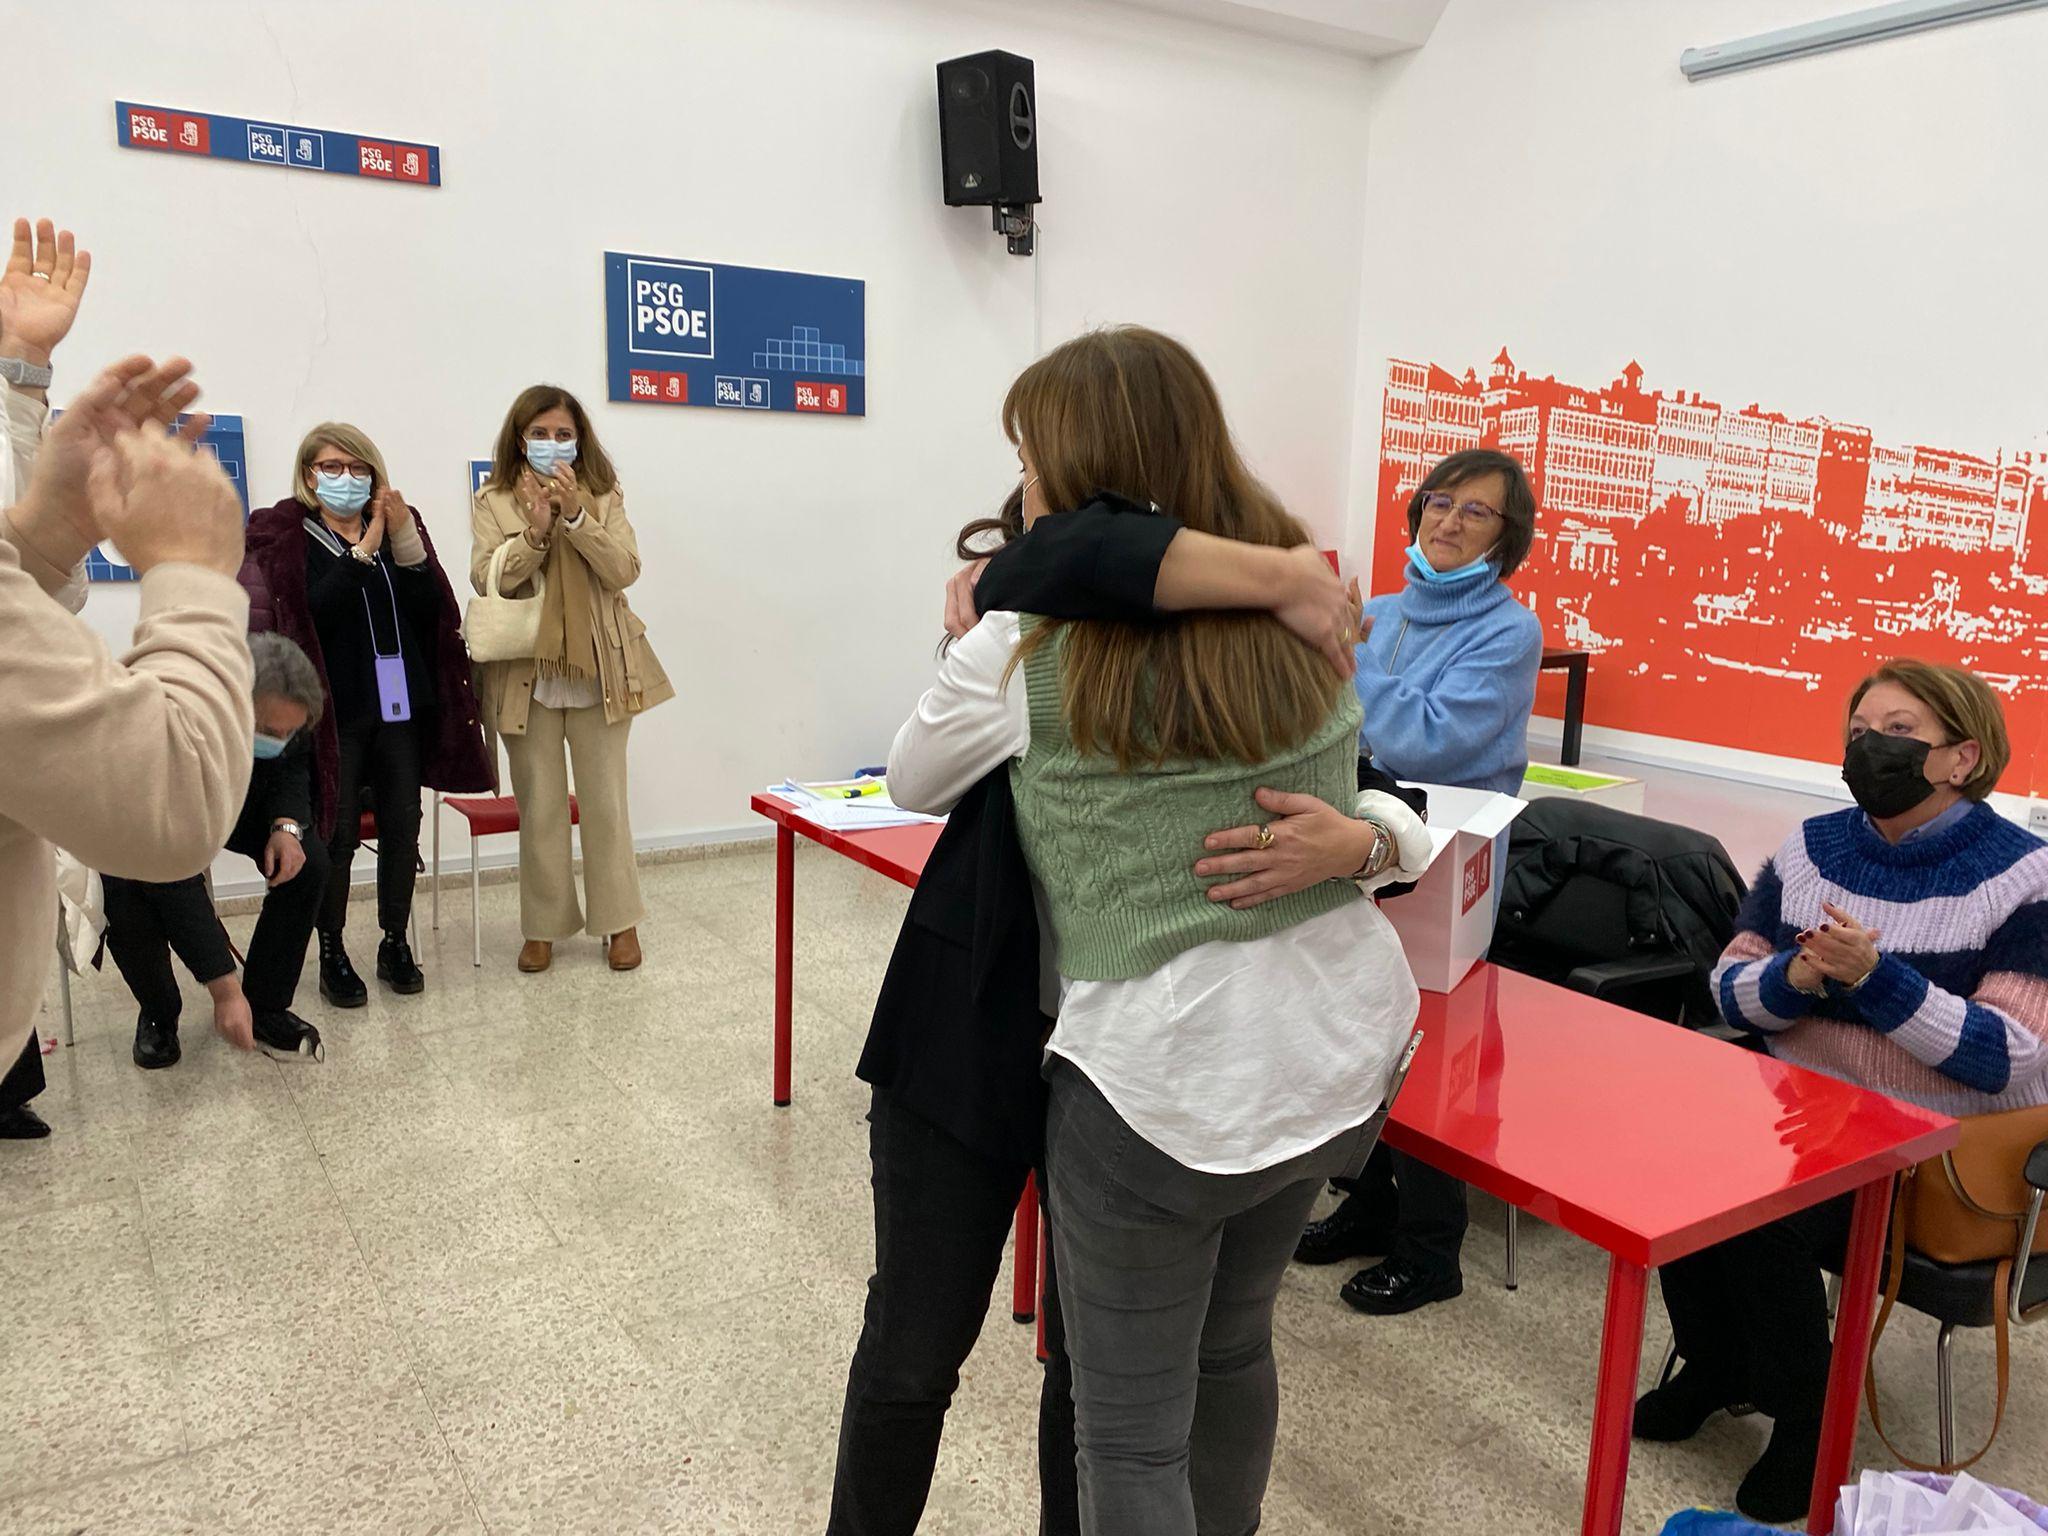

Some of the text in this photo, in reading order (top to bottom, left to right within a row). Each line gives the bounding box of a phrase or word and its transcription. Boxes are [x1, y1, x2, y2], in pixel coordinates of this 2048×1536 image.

[131, 114, 155, 128] PSG
[132, 125, 168, 142] PSOE
[252, 142, 283, 157] PSOE
[361, 146, 382, 159] PSG
[362, 157, 393, 173] PSOE
[637, 305, 707, 338] PSOE
[632, 384, 658, 396] PSOE
[718, 390, 741, 401] PSOE
[797, 395, 820, 407] PSOE
